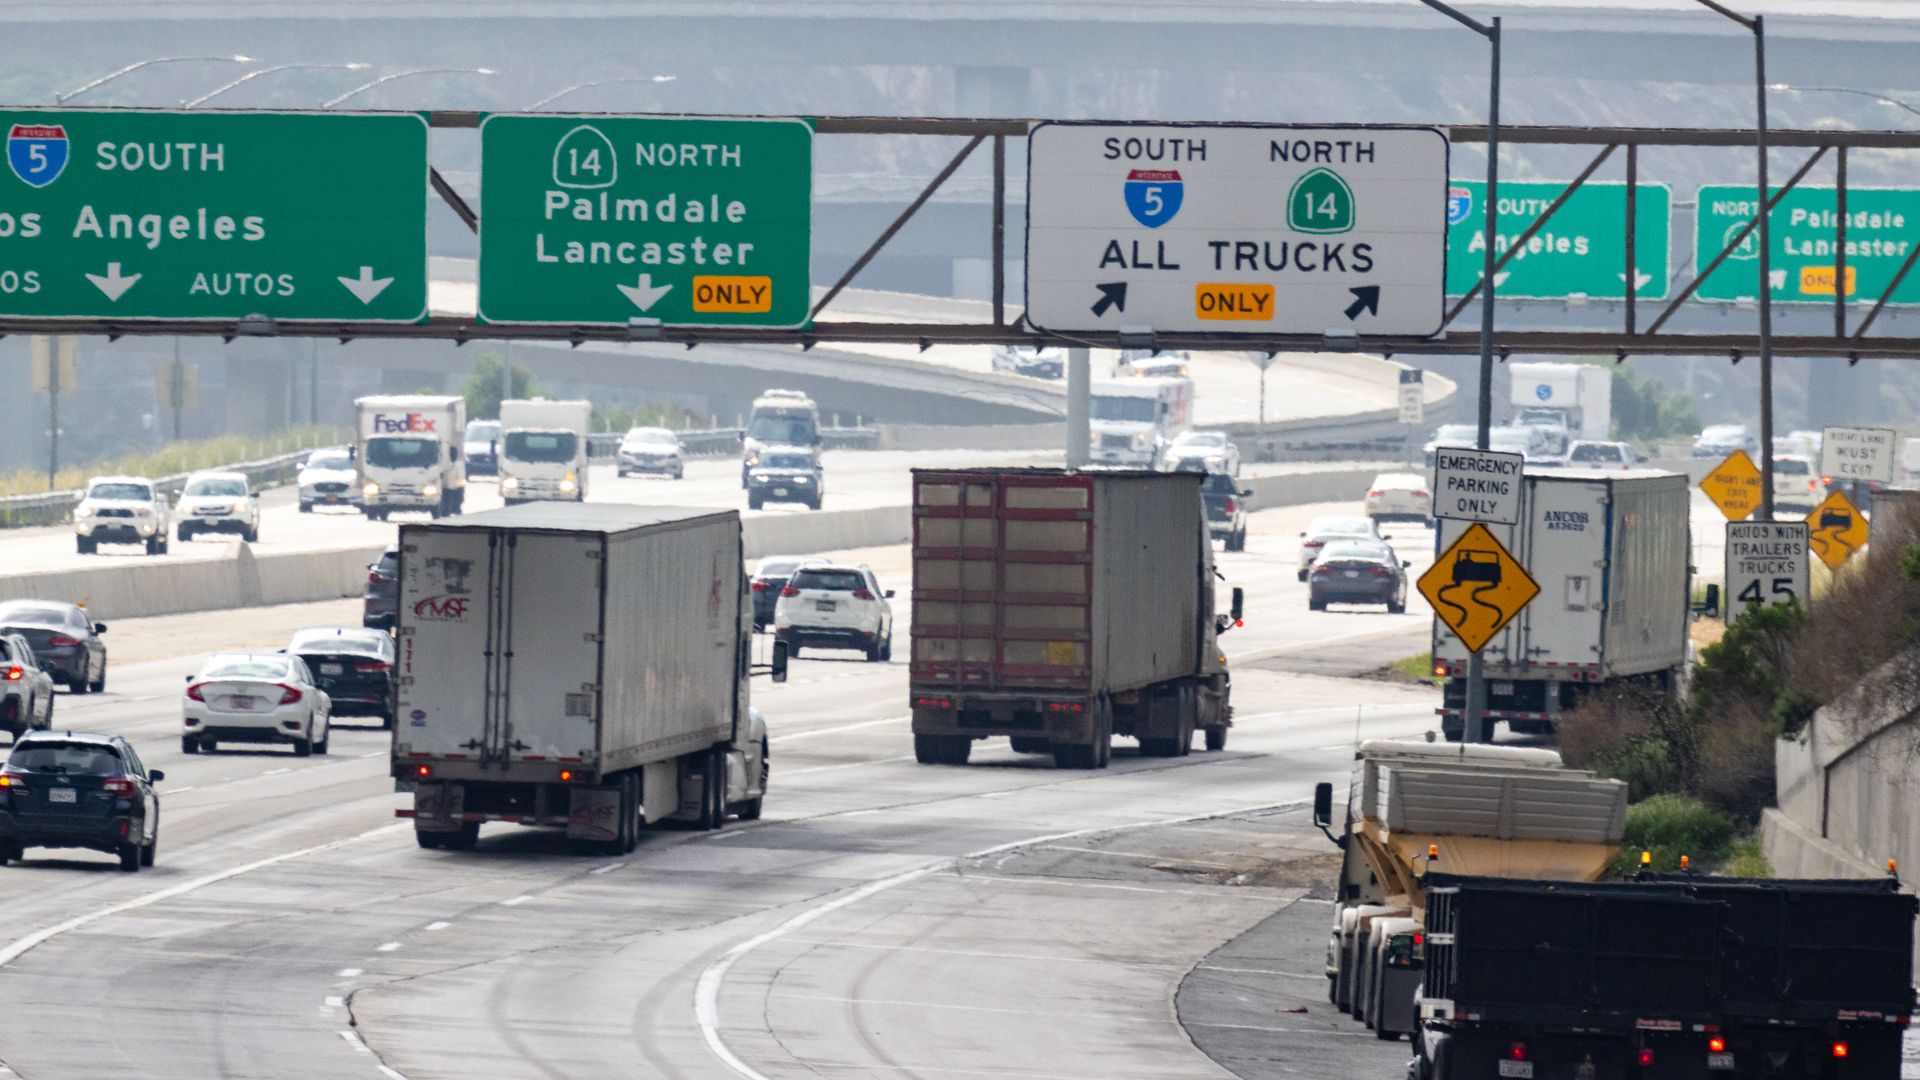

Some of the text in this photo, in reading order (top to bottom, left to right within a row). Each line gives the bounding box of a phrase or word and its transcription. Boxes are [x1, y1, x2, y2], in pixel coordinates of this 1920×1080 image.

[30, 144, 47, 173] 5
[96, 141, 225, 172] SOUTH
[569, 148, 601, 176] 14
[634, 142, 742, 168] NORTH
[1104, 138, 1207, 162] SOUTH
[1270, 140, 1375, 164] NORTH
[545, 190, 747, 223] Palmdale
[1145, 186, 1163, 216] 5
[1304, 192, 1338, 221] 14
[72, 205, 266, 250] Angeles
[536, 233, 755, 265] Lancaster
[1099, 239, 1374, 273] ALL TRUCKS
[0, 270, 41, 294] OS
[189, 272, 296, 297] AUTOS
[696, 284, 767, 304] ONLY
[1199, 292, 1270, 313] ONLY
[374, 412, 437, 433] FedEx
[1439, 455, 1519, 475] EMERGENCY
[1837, 446, 1878, 460] MUST
[1448, 477, 1509, 496] PARKING
[1457, 498, 1498, 514] ONLY
[1730, 526, 1804, 539] AUTOS WITH
[1733, 542, 1802, 556] TRAILERS
[1738, 561, 1796, 575] TRUCKS
[1737, 578, 1799, 608] 45
